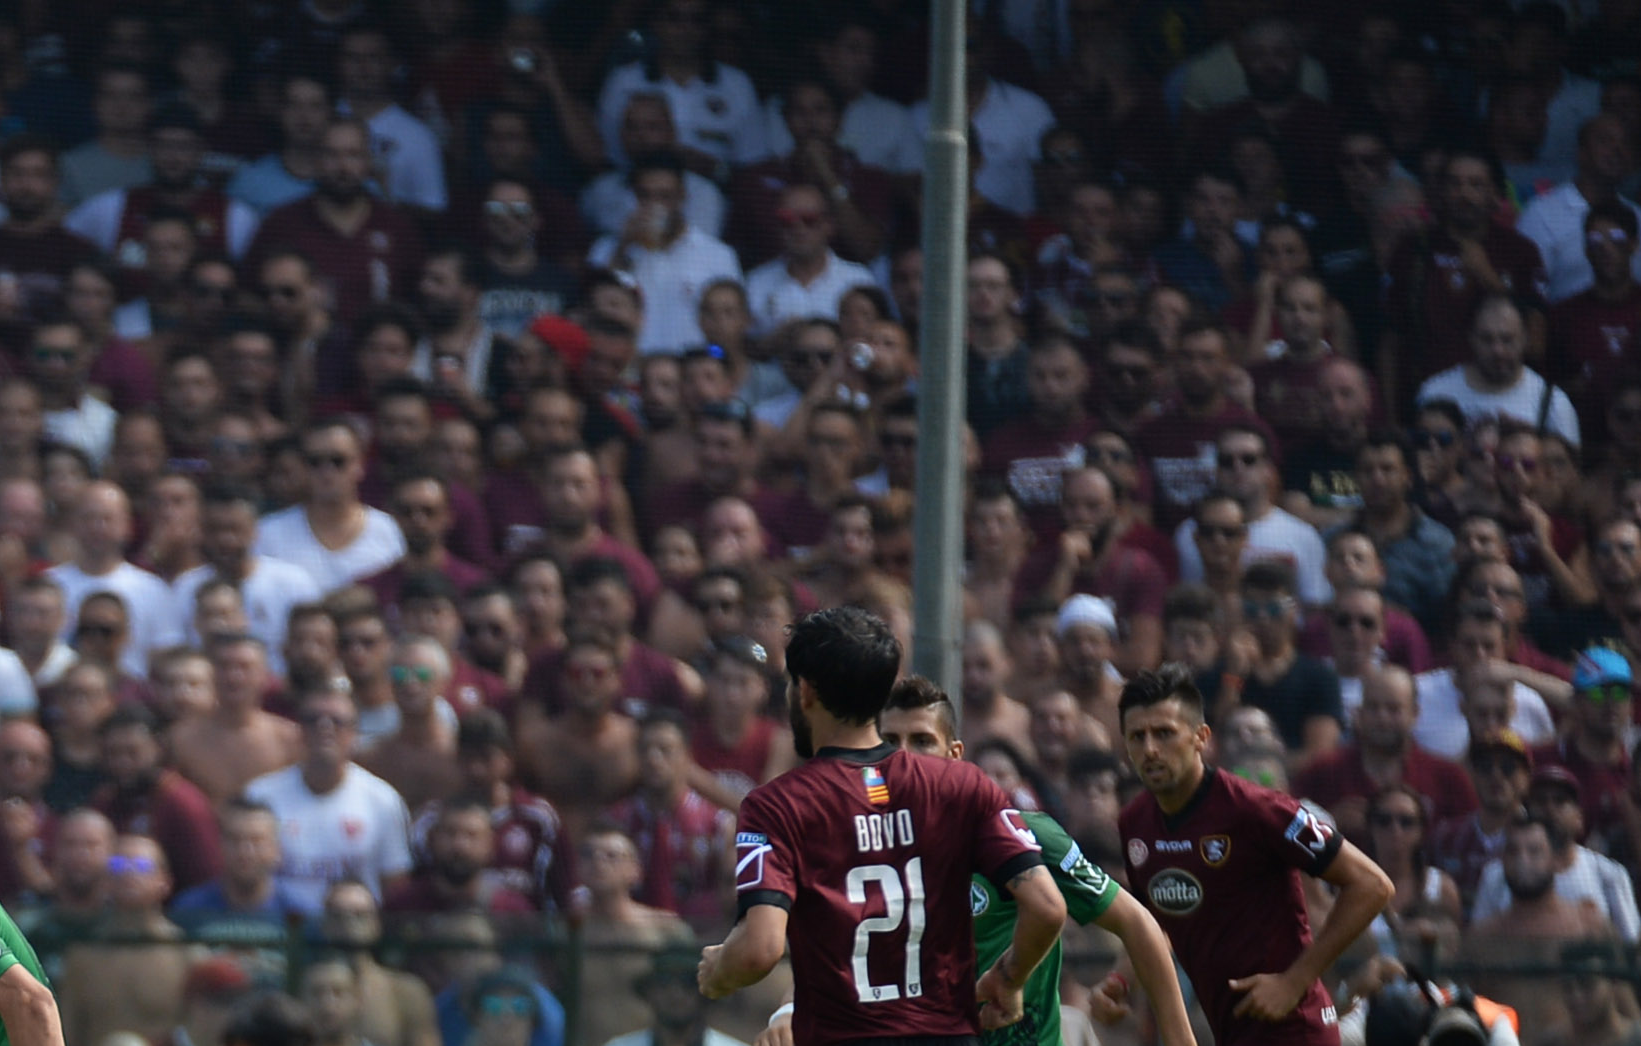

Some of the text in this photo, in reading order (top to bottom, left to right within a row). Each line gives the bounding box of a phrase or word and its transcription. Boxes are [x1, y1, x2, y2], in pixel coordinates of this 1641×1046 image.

[854, 809, 914, 852] BOVO
[1153, 882, 1198, 901] motta
[846, 857, 925, 1002] 21
